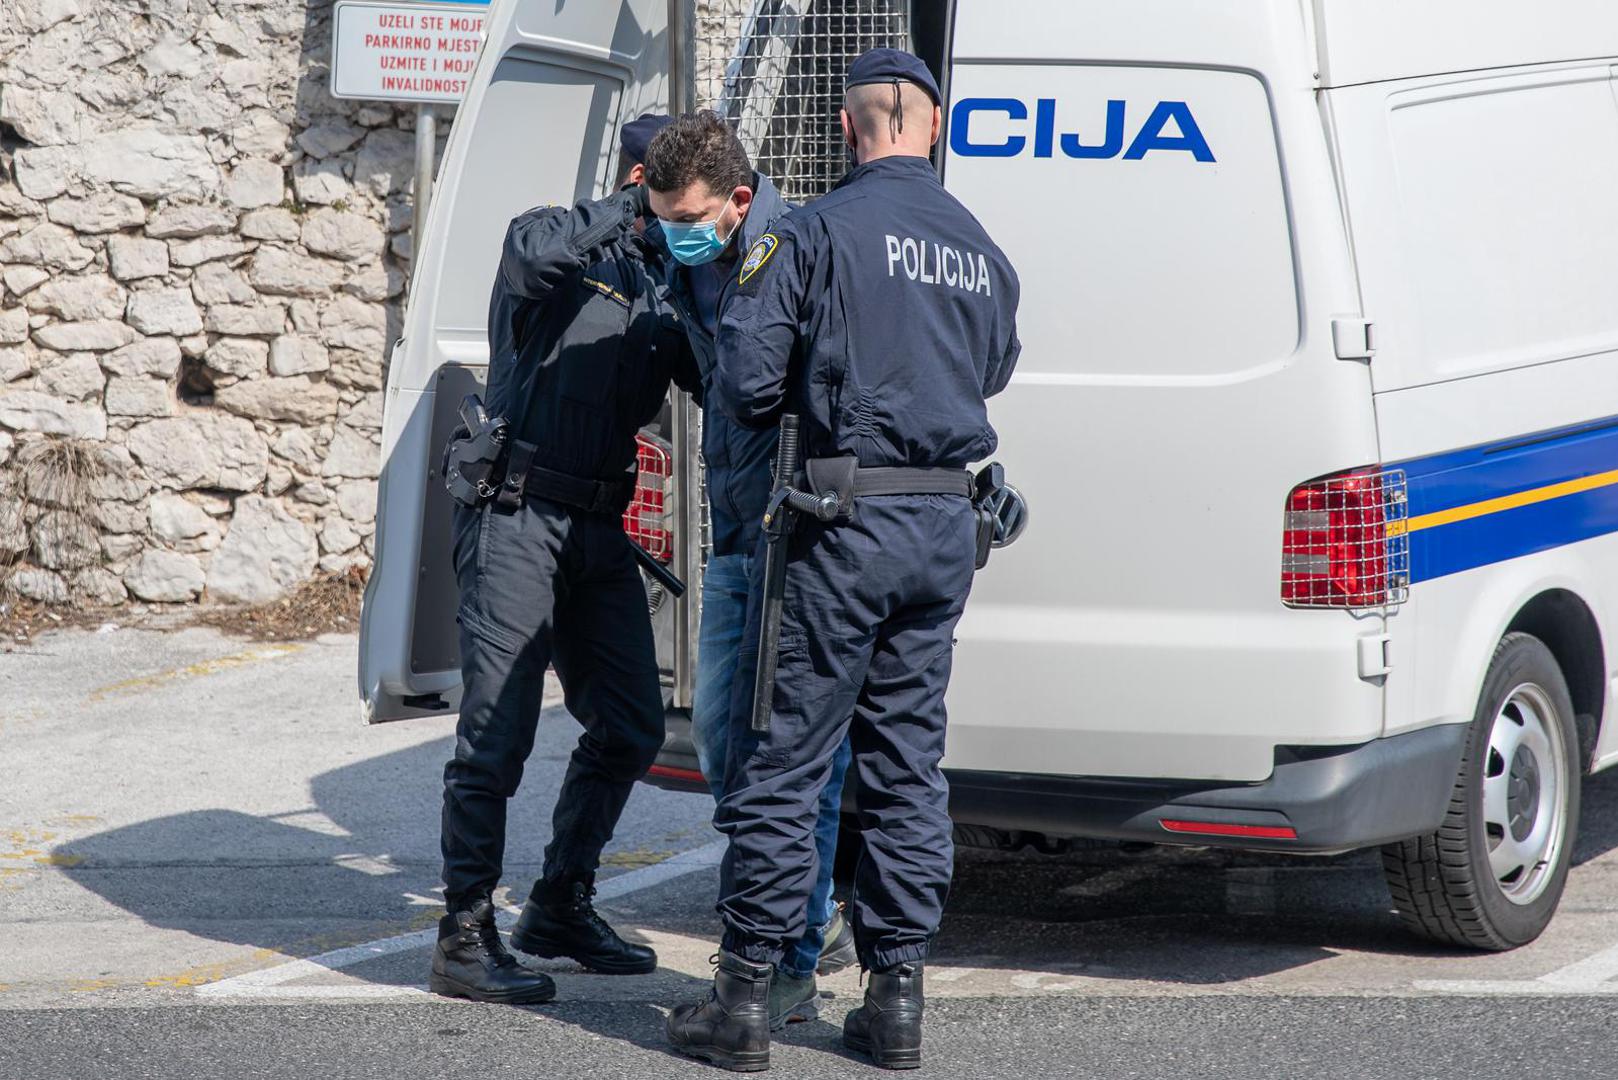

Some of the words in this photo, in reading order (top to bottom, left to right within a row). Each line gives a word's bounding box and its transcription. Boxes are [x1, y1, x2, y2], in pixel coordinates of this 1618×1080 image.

[379, 14, 414, 28] UZELI
[421, 16, 444, 31] STE
[365, 34, 431, 50] PARKIRNO
[438, 38, 480, 53] MJEST
[380, 56, 426, 71] UZMITE
[433, 58, 437, 71] I
[382, 76, 467, 93] INVALIDNOST
[950, 97, 1217, 163] CIJA
[885, 234, 992, 297] POLICIJA
